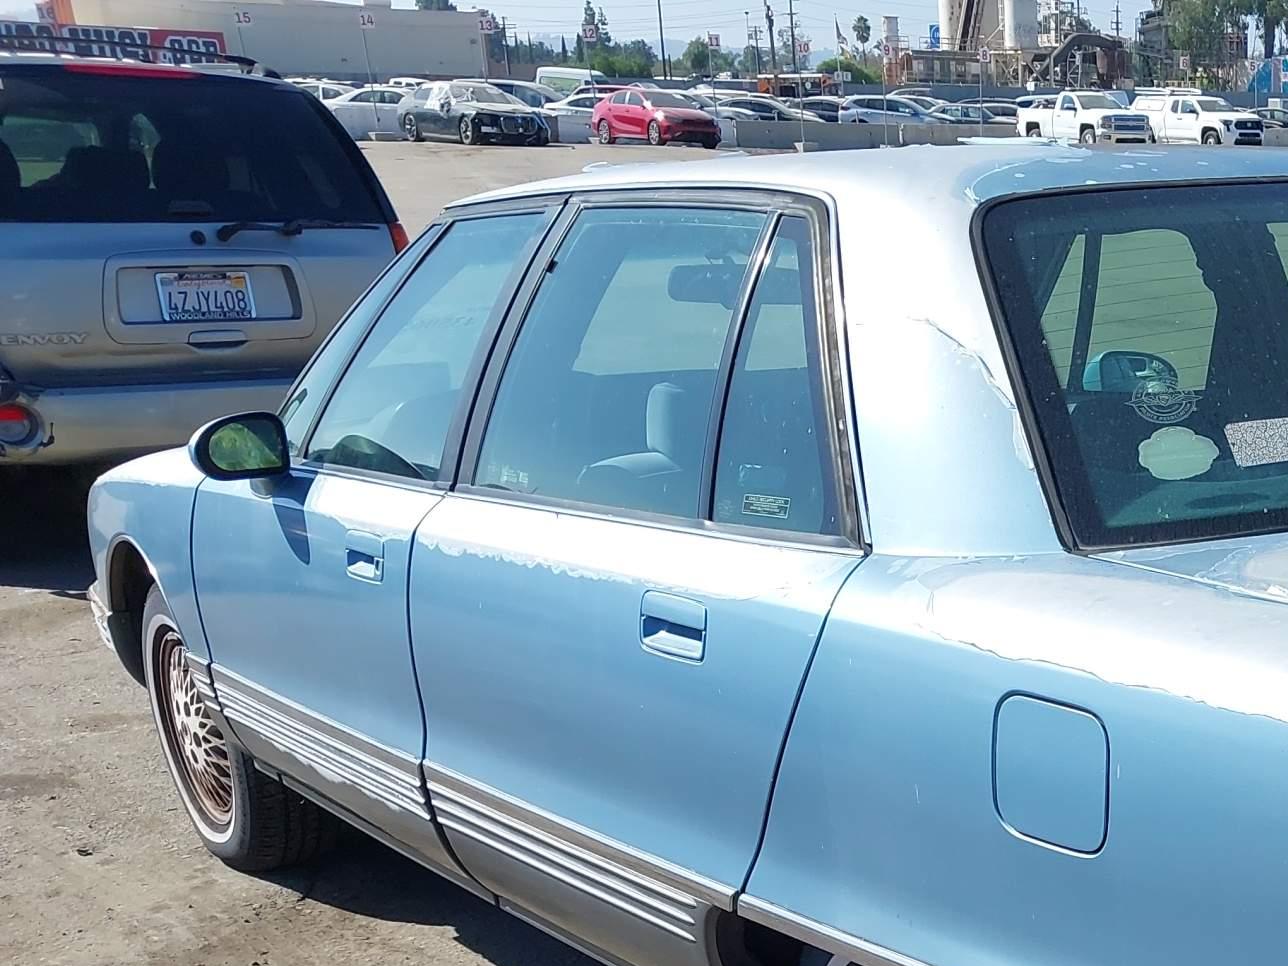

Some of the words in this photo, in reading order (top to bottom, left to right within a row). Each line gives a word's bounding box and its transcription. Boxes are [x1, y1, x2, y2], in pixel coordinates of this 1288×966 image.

[235, 12, 250, 24] 15
[360, 14, 374, 26] 14
[480, 20, 493, 31] 13
[583, 28, 595, 39] 12
[708, 36, 720, 47] 11
[798, 43, 810, 53] 10
[883, 44, 890, 56] 9
[981, 48, 988, 61] 8
[1182, 57, 1188, 68] 6
[1250, 61, 1256, 72] 5
[167, 290, 248, 313] 4ZJY408
[171, 311, 224, 321] WOODLAND
[226, 311, 251, 319] HILLS
